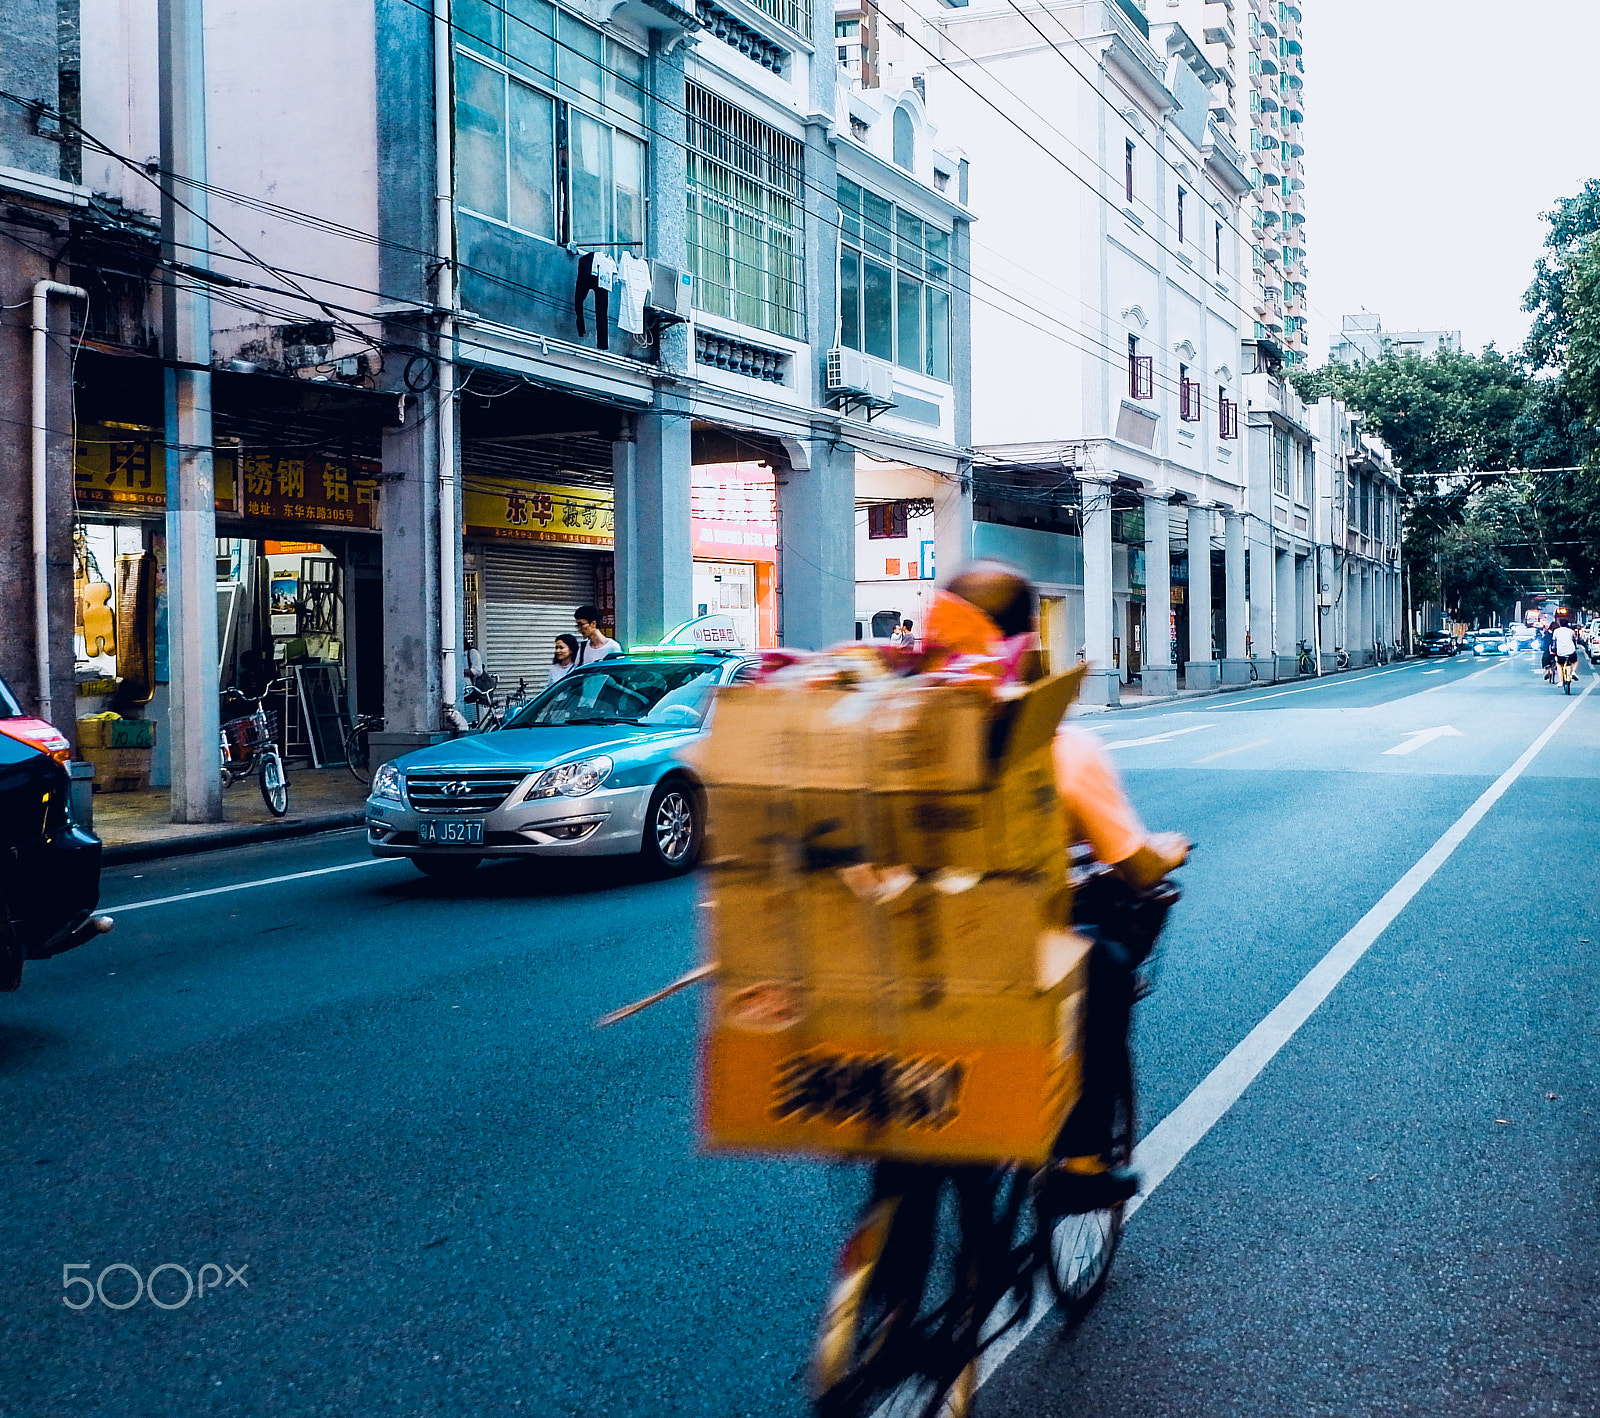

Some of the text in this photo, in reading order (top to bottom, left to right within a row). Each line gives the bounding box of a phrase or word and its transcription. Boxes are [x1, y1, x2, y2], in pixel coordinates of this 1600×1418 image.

[504, 489, 554, 528] 东华
[703, 628, 734, 641] 白云集团
